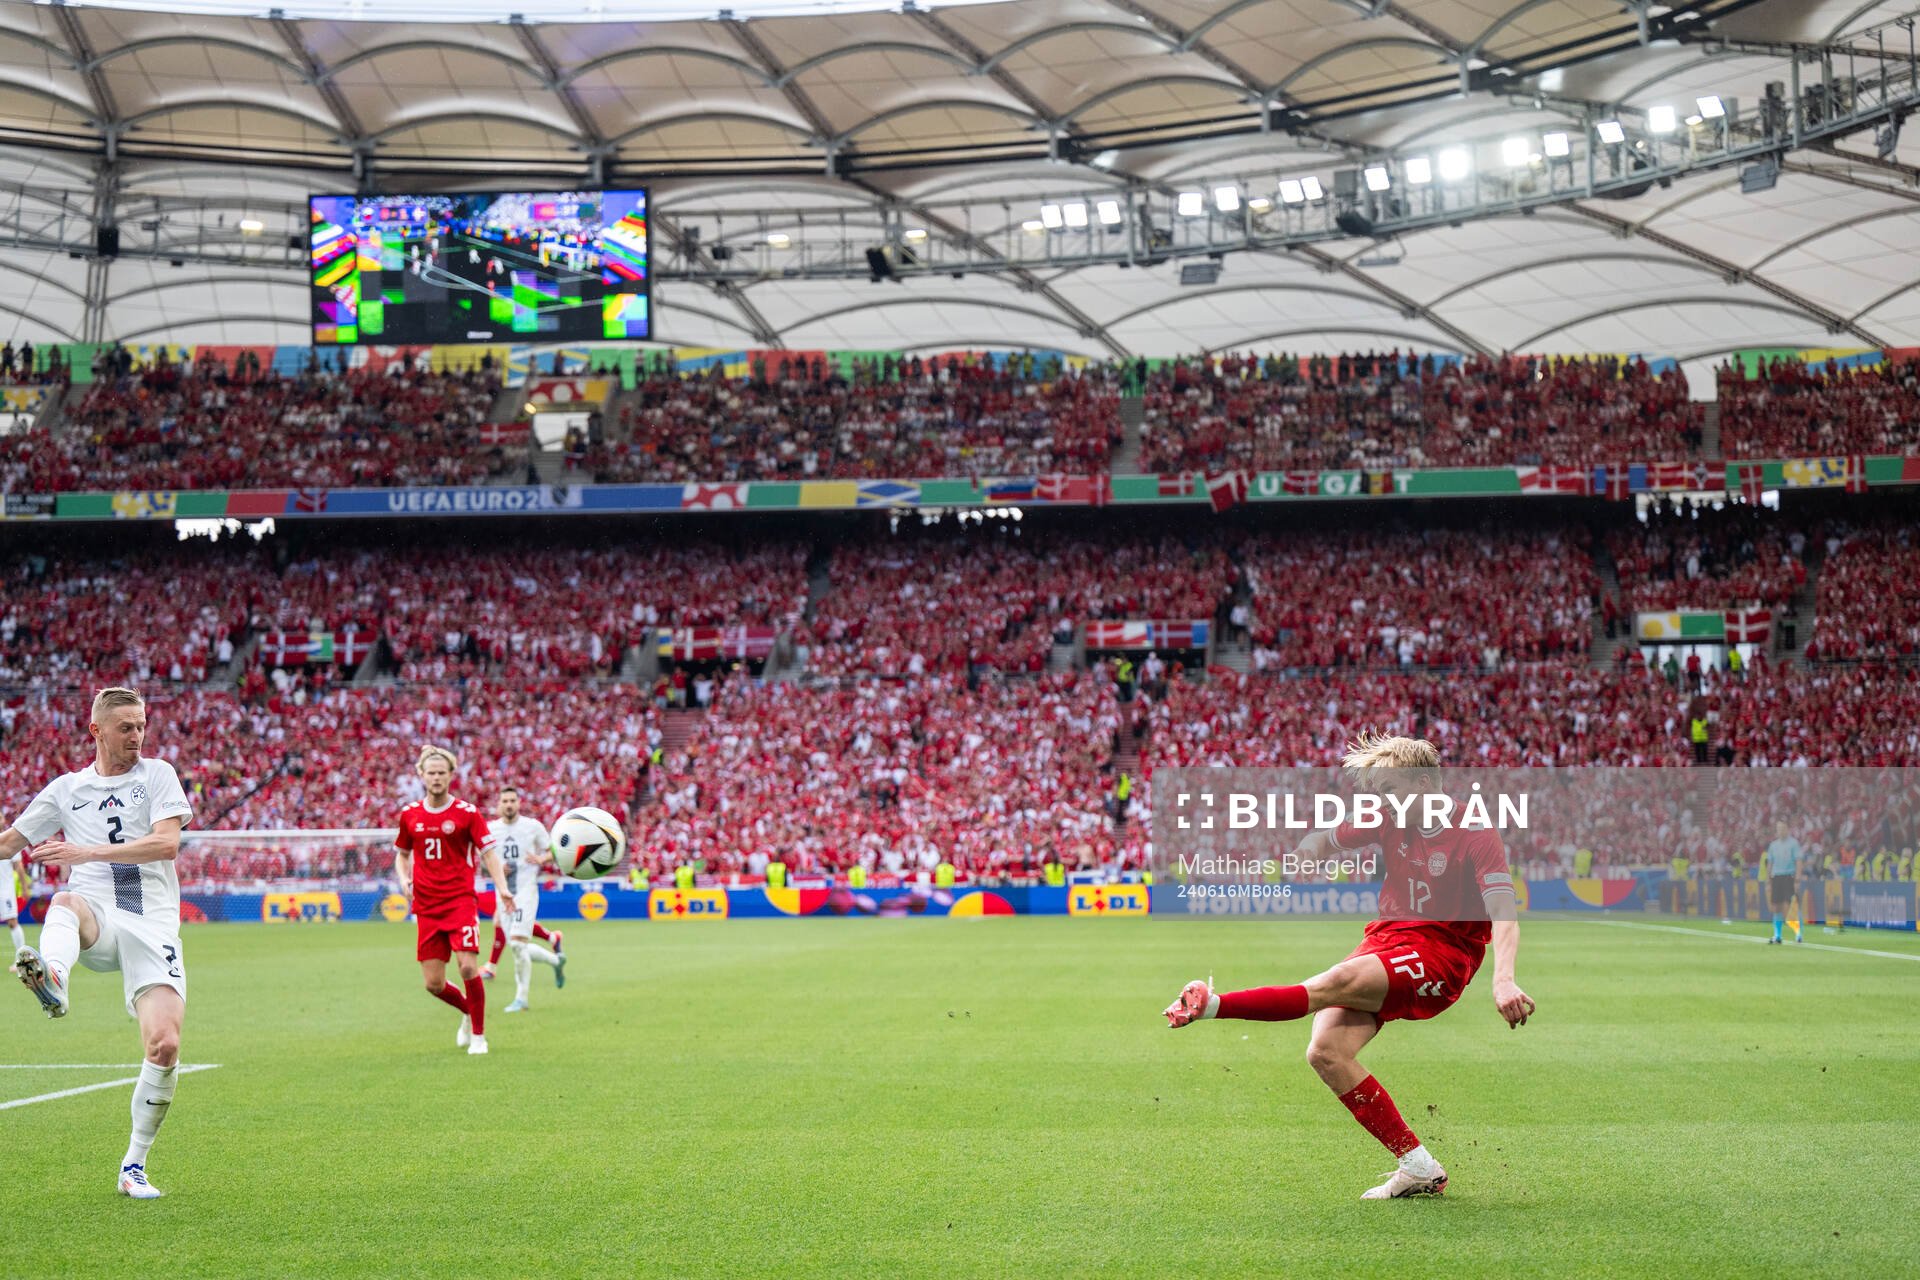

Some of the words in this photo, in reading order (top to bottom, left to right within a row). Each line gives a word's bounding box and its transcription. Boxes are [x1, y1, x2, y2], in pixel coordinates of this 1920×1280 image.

[107, 816, 125, 844] 2
[425, 838, 442, 859] 21
[503, 845, 519, 859] 20
[1188, 887, 1380, 915] #onyourtea
[1408, 877, 1432, 914] 17
[462, 925, 479, 948] 21
[1390, 951, 1425, 980] 17
